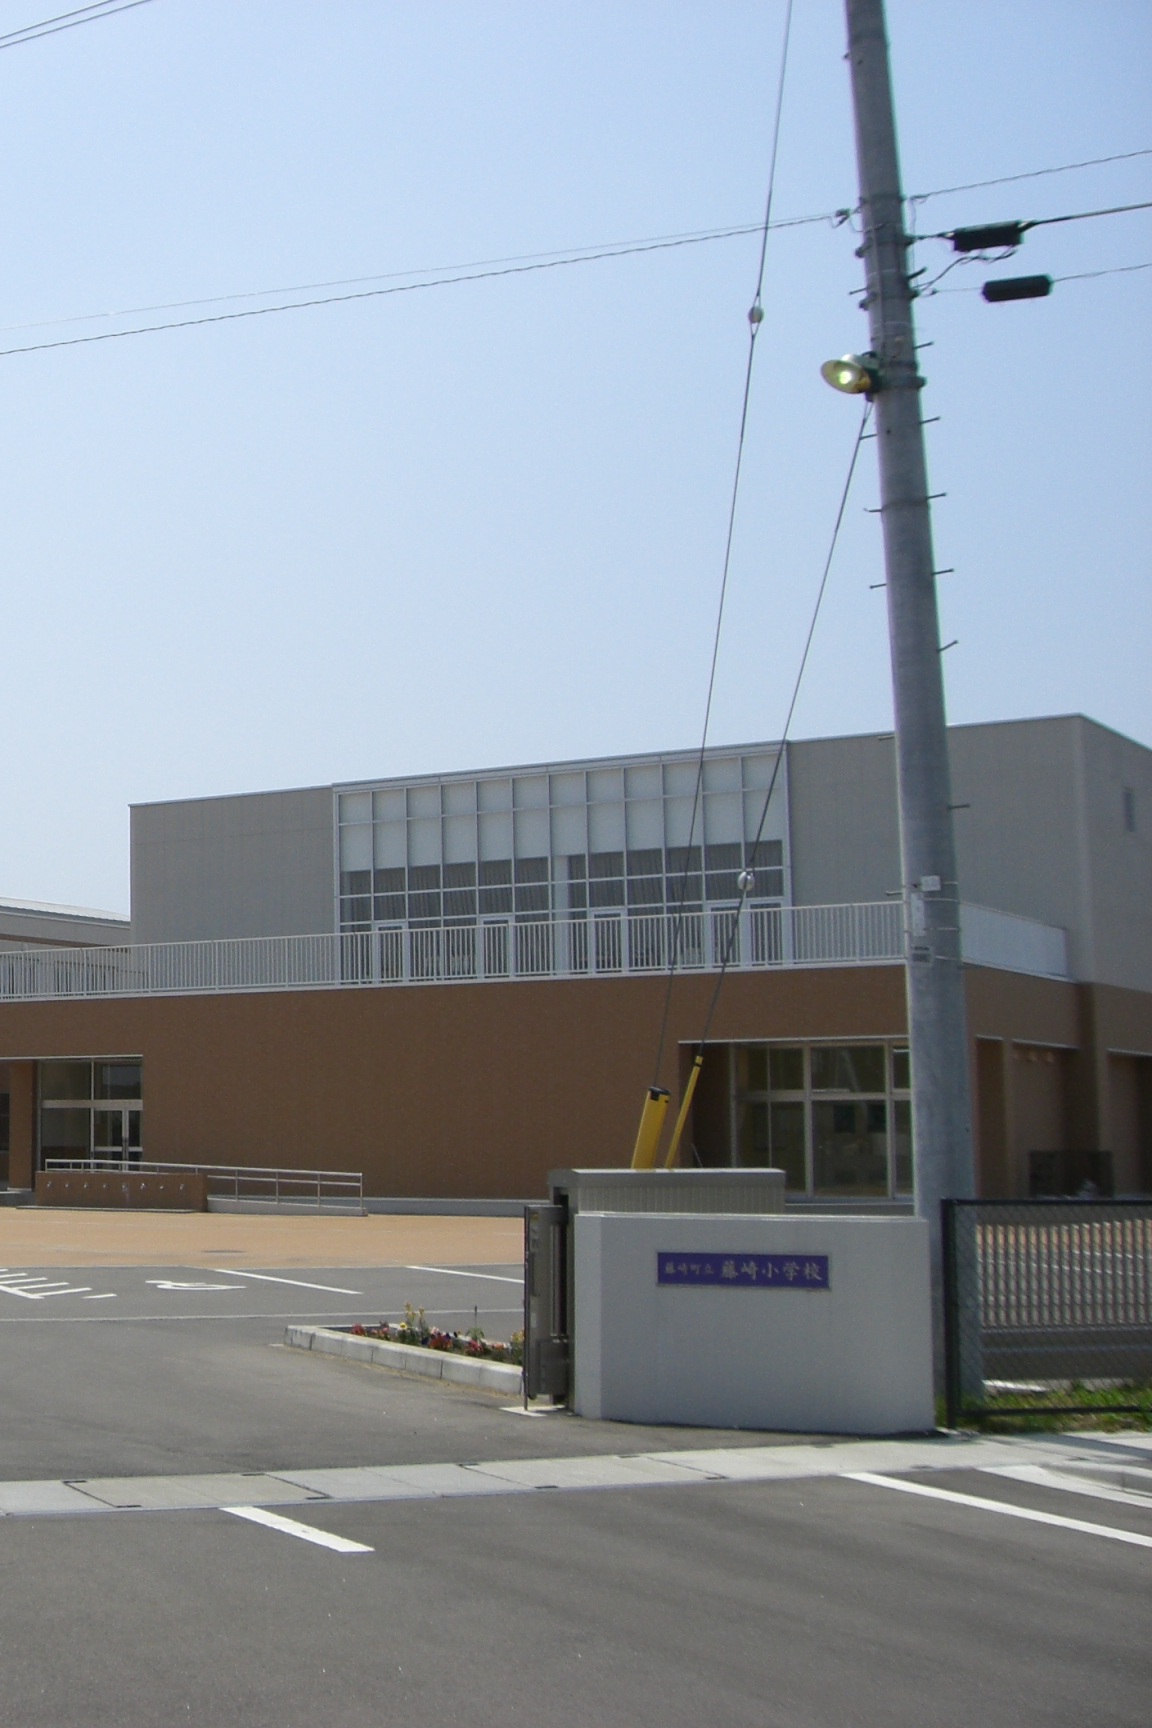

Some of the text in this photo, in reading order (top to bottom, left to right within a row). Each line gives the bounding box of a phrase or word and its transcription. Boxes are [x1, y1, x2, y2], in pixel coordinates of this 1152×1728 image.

[722, 1259, 823, 1281] 藤崎小学校
